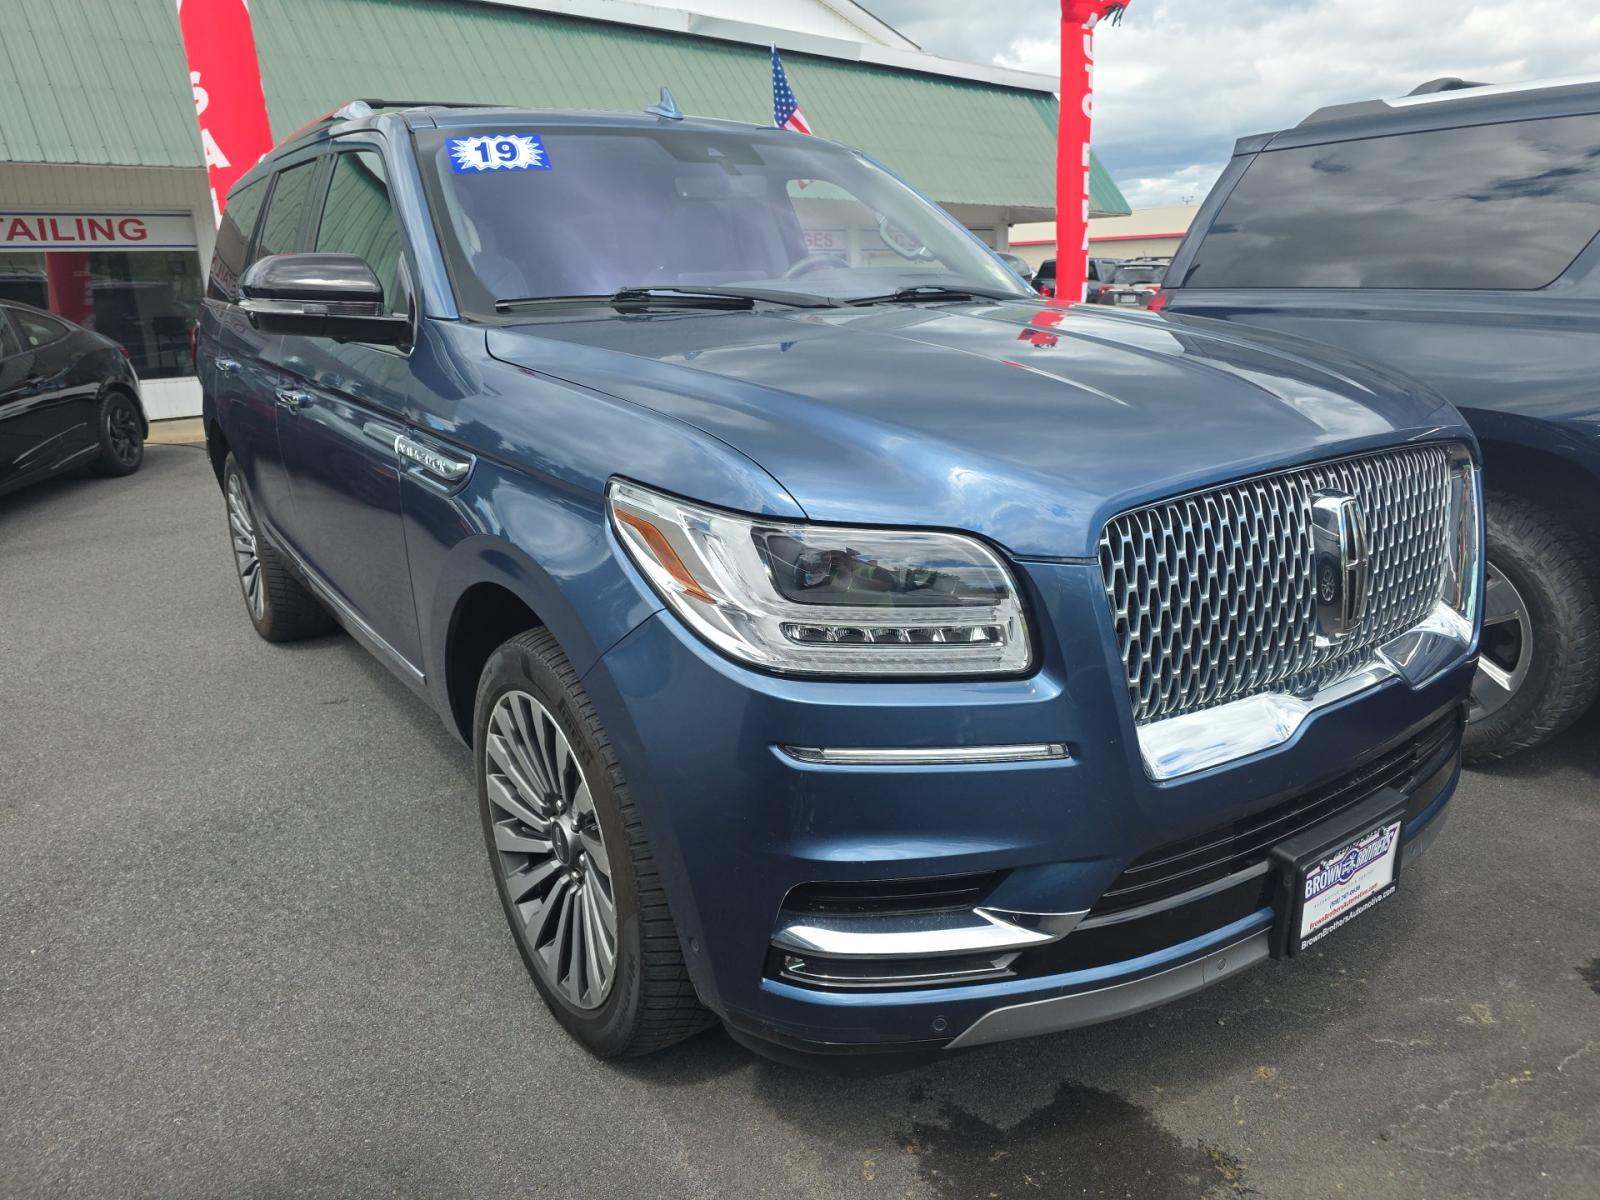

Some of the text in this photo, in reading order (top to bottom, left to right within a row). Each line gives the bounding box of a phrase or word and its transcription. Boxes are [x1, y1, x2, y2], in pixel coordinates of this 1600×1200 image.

[474, 140, 518, 163] 19
[0, 217, 148, 242] AILING
[1304, 862, 1343, 899] BROWN
